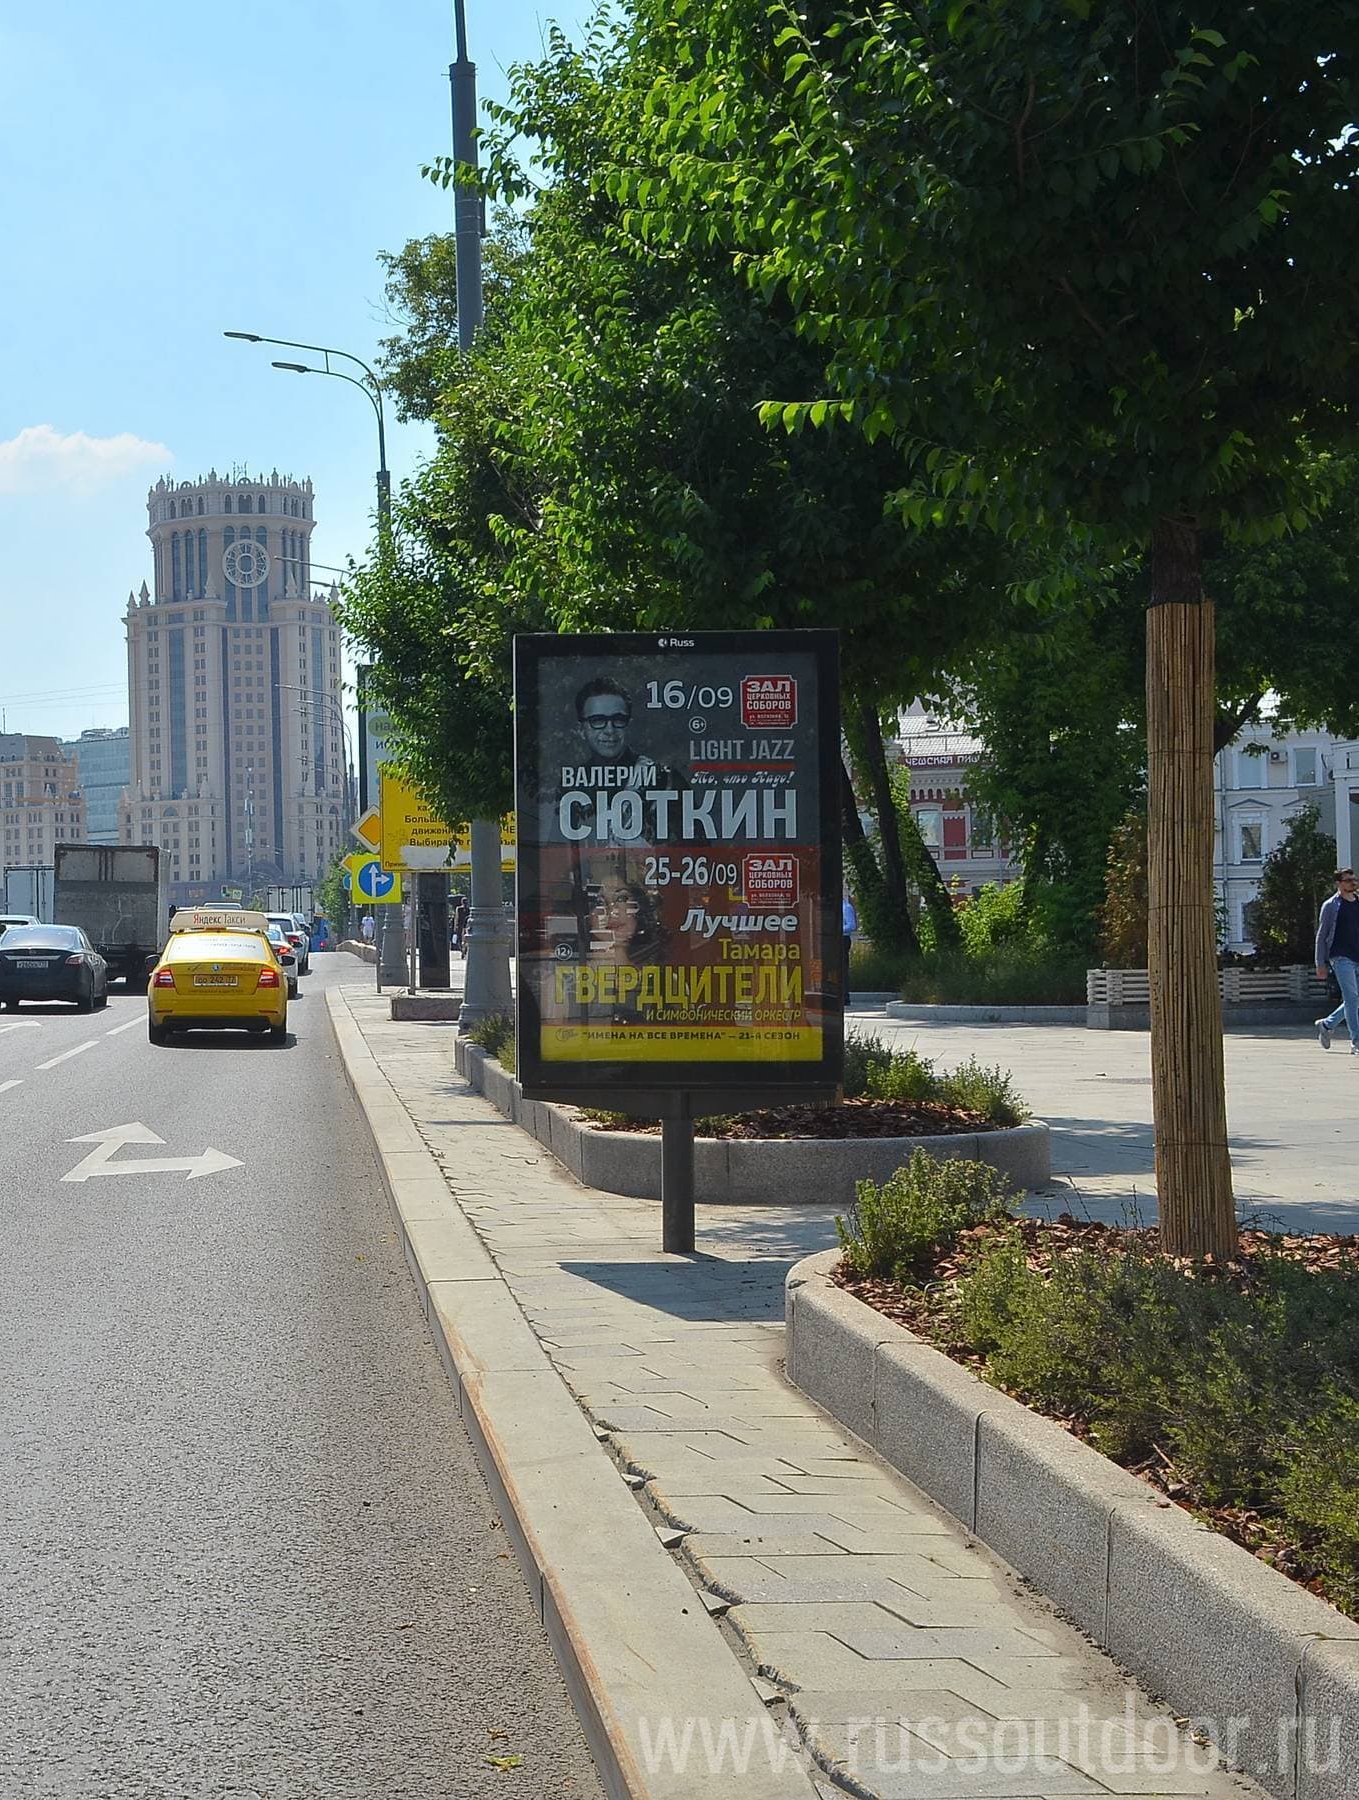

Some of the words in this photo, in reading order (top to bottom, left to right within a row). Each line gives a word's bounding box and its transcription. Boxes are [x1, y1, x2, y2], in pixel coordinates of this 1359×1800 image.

[669, 638, 695, 647] Russ
[746, 680, 791, 692] ЗАЛ
[646, 680, 734, 709] 16/09
[746, 692, 791, 700] ЦЕРКОВНЫХ
[746, 700, 791, 710] СОБОРОВ
[692, 719, 705, 729] 6+
[689, 740, 744, 761] LIGHT
[748, 739, 795, 760] JAZZ
[561, 763, 657, 788] ВАЛЕРИЙ
[559, 788, 797, 841] СЮТКИН
[644, 856, 738, 885] 25-26/09
[748, 859, 793, 871] ЗАЛ
[749, 871, 793, 879] ЦЕРКОВНЫХ
[748, 879, 793, 889] СОБОРОВ
[193, 913, 222, 925] Яндекс
[224, 913, 246, 924] Такси
[680, 908, 798, 938] Лучшее
[718, 937, 801, 964] Тамара
[554, 964, 803, 1011] ГВЕРДЦИТЕЛИ
[646, 1009, 654, 1020] И
[656, 1008, 753, 1021] СИМФОНИЧЕСКИЙ
[755, 1009, 802, 1021] ОРКЕСТР
[628, 1031, 645, 1040] НА
[647, 1031, 667, 1040] ВСЕ
[669, 1031, 726, 1040] ВРЕМЕНА"
[764, 1031, 801, 1040] СЕЗОН
